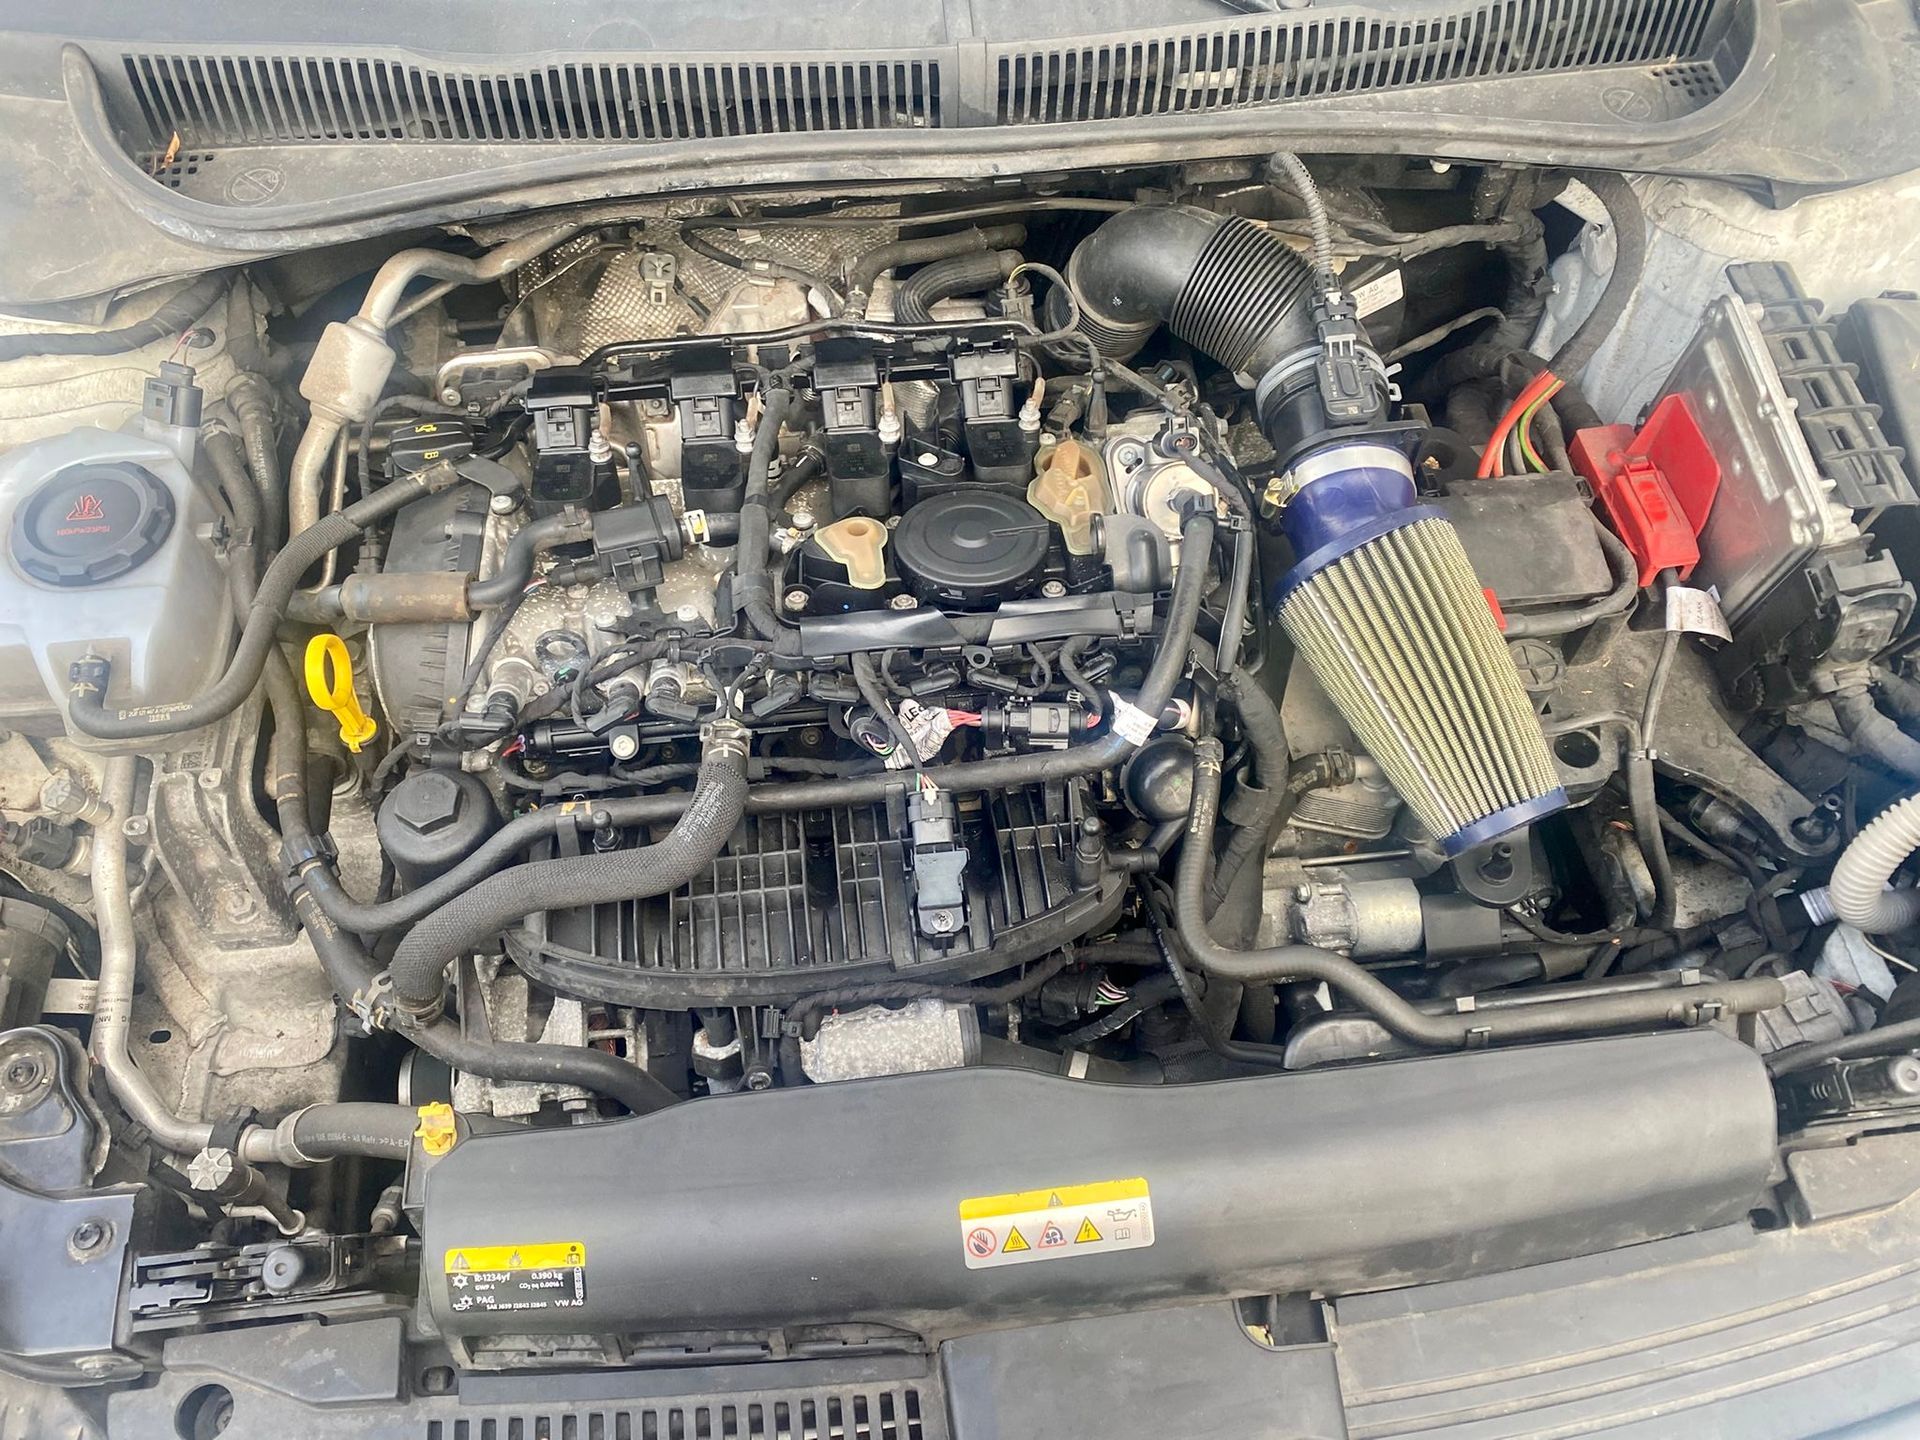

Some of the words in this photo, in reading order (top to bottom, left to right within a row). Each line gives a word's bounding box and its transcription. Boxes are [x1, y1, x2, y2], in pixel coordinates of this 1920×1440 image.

[474, 1272, 511, 1284] R-1234yf
[531, 1272, 552, 1281] 0.390
[553, 1271, 564, 1281] kg
[476, 1296, 495, 1304] PAG
[554, 1300, 569, 1308] VW
[571, 1299, 584, 1307] AG
